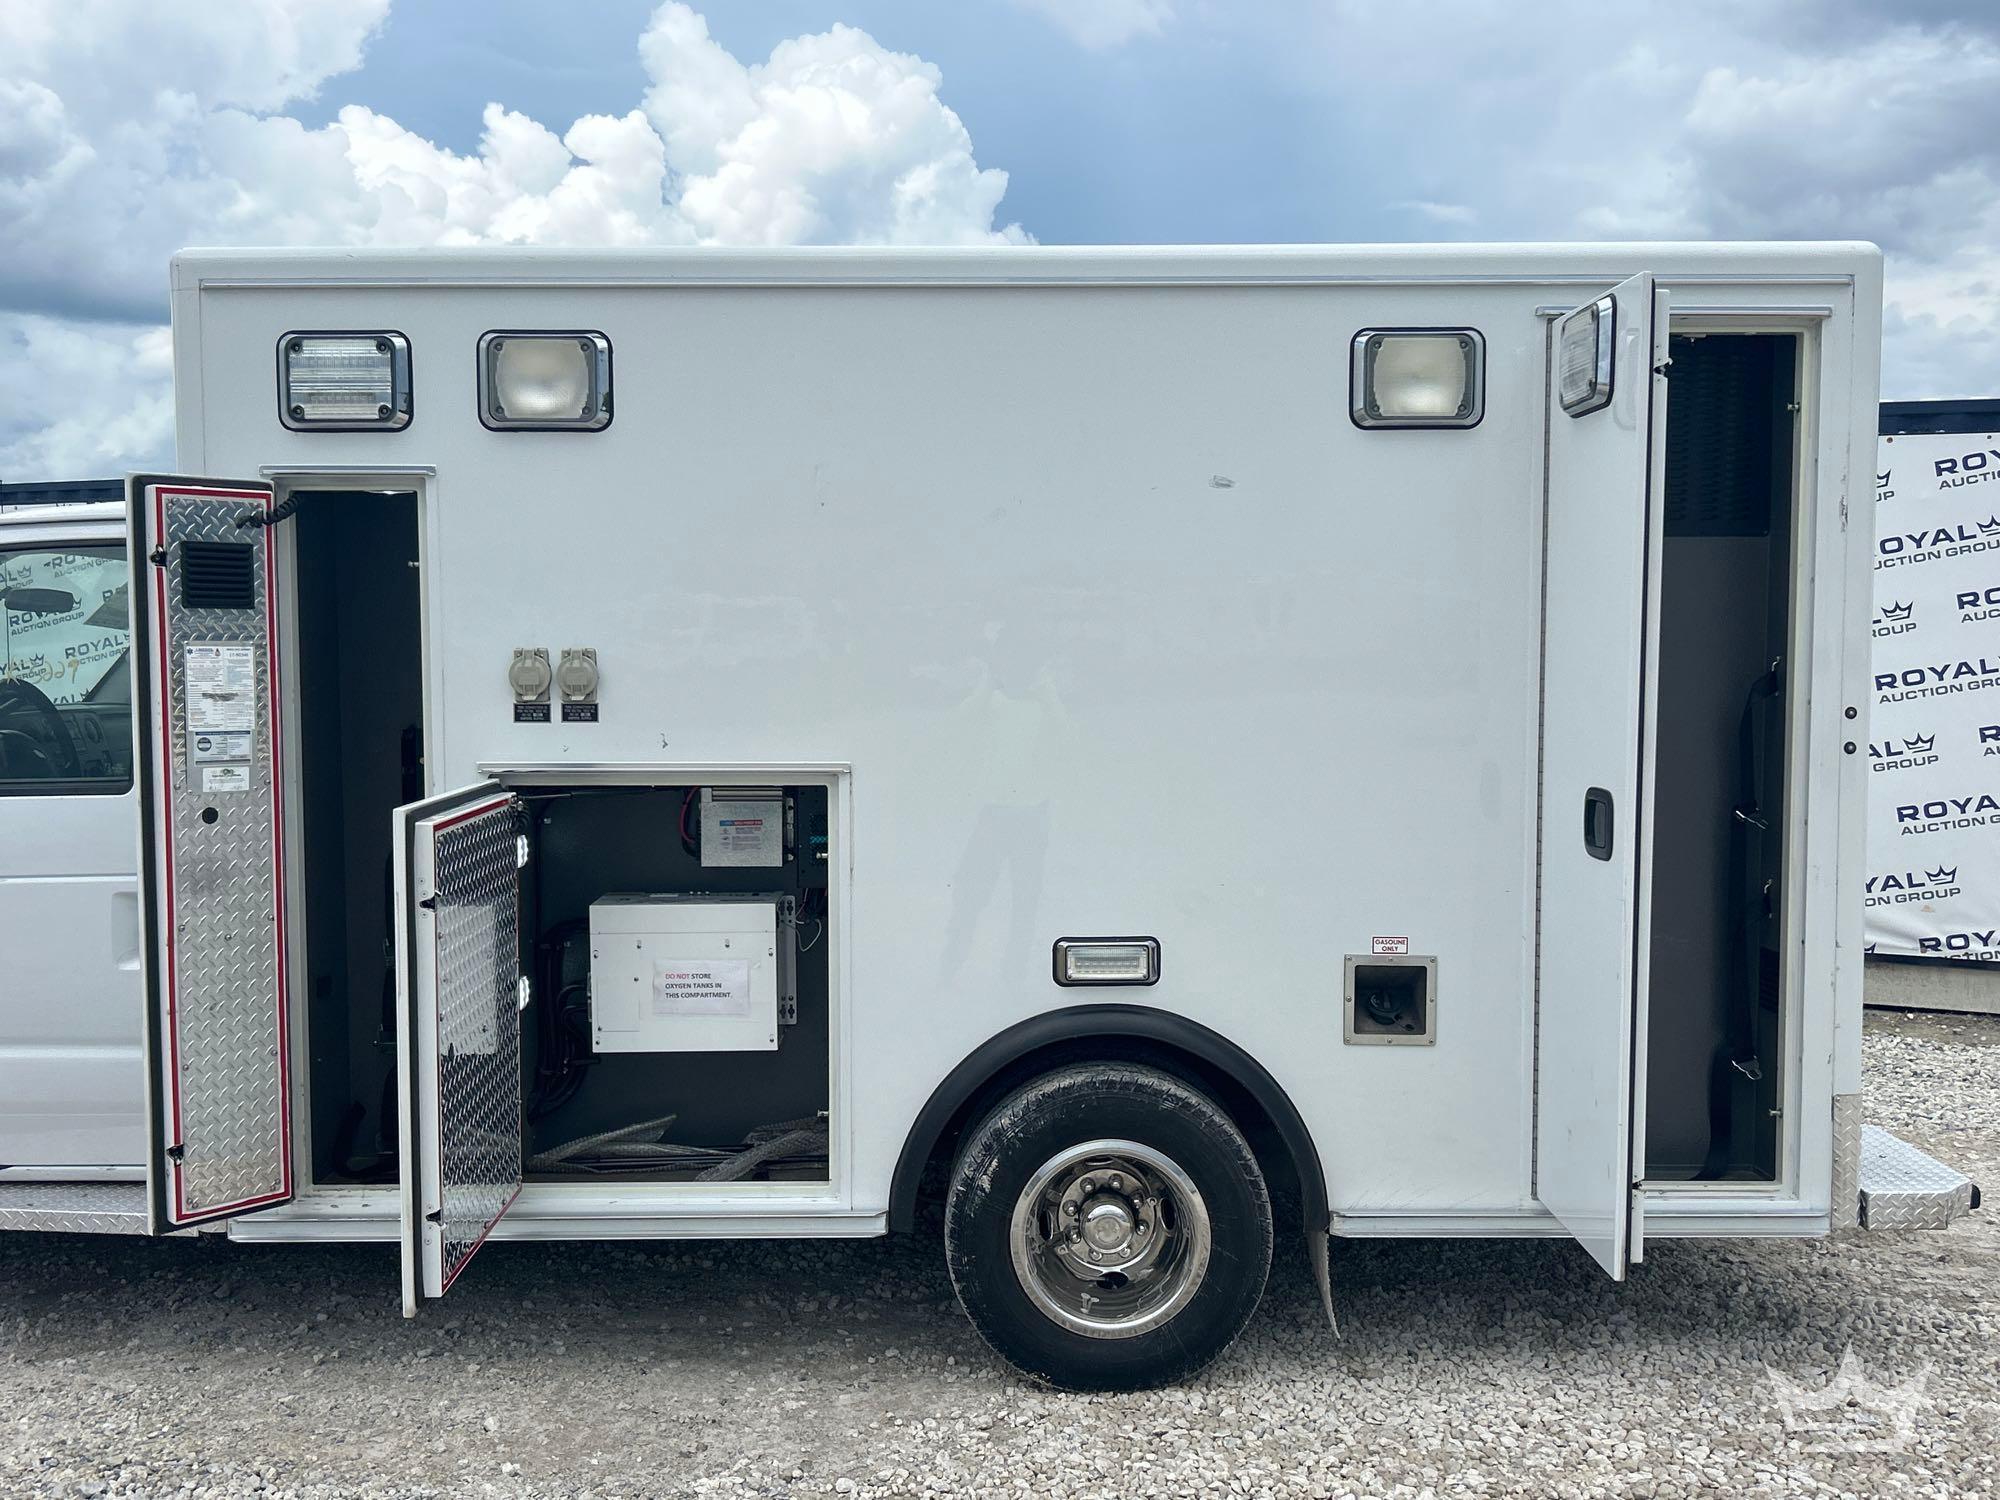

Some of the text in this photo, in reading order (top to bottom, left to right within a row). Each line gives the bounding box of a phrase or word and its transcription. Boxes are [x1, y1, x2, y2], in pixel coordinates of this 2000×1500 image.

[1939, 470, 2000, 490] AUCTI
[1879, 525, 1977, 554] OYAL
[1874, 539, 2000, 570] UCTION GROU
[65, 635, 123, 659] ROYAL
[1875, 658, 1999, 691] ROYAL
[1879, 683, 1964, 704] AUCTION
[1873, 755, 1939, 772] GROUP
[1896, 795, 2000, 822] ROYA
[1901, 816, 1986, 836] AUCTION
[1865, 873, 1926, 893] YAL
[1895, 887, 1960, 904] GROUP
